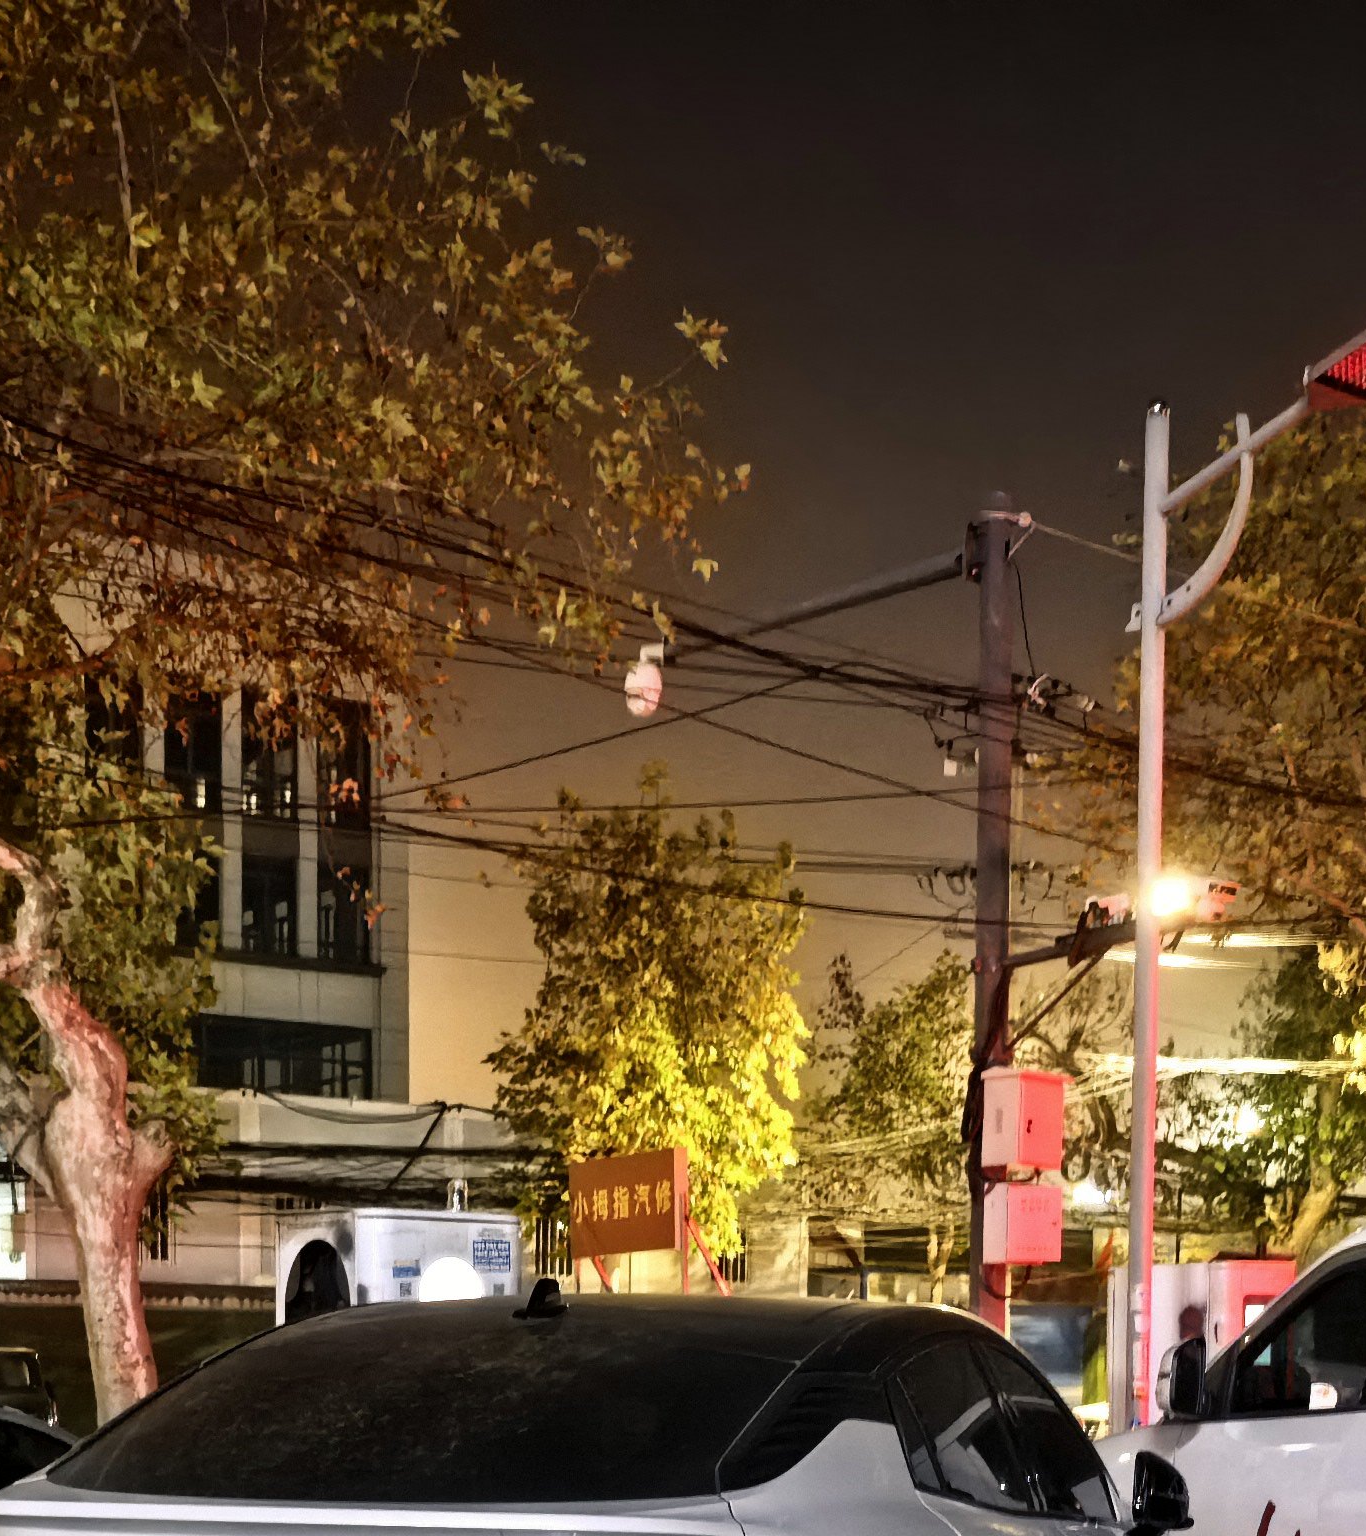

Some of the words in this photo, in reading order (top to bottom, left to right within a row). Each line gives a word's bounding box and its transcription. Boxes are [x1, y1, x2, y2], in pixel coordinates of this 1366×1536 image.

[573, 1179, 671, 1224] 小拇指汽修
